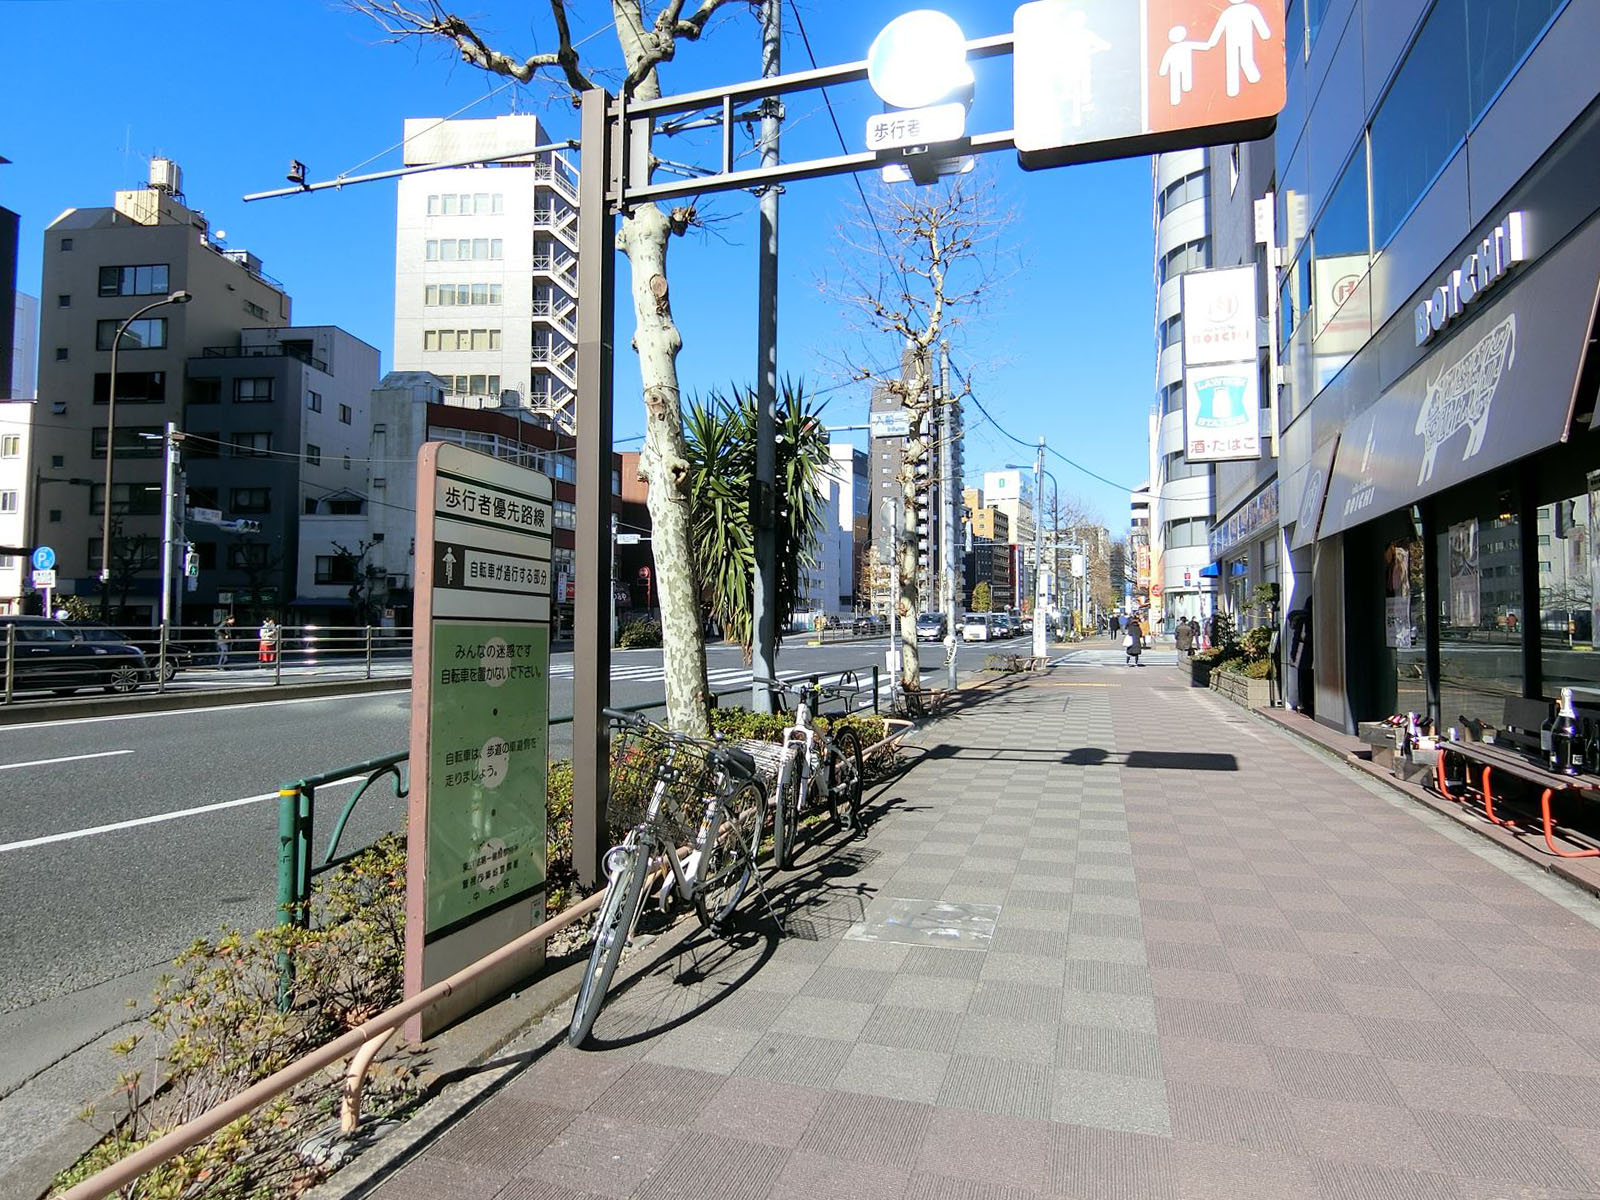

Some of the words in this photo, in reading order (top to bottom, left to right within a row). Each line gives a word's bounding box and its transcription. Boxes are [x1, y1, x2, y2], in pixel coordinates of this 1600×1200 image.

[1415, 210, 1525, 347] BOICHI
[445, 486, 545, 528] 歩行者優先路線
[469, 561, 547, 586] 自転車が通行する部分
[455, 643, 532, 660] みんなの迷惑です
[441, 663, 542, 685] 自転車を置かないで下さい。
[445, 765, 498, 788] 走りましょう。
